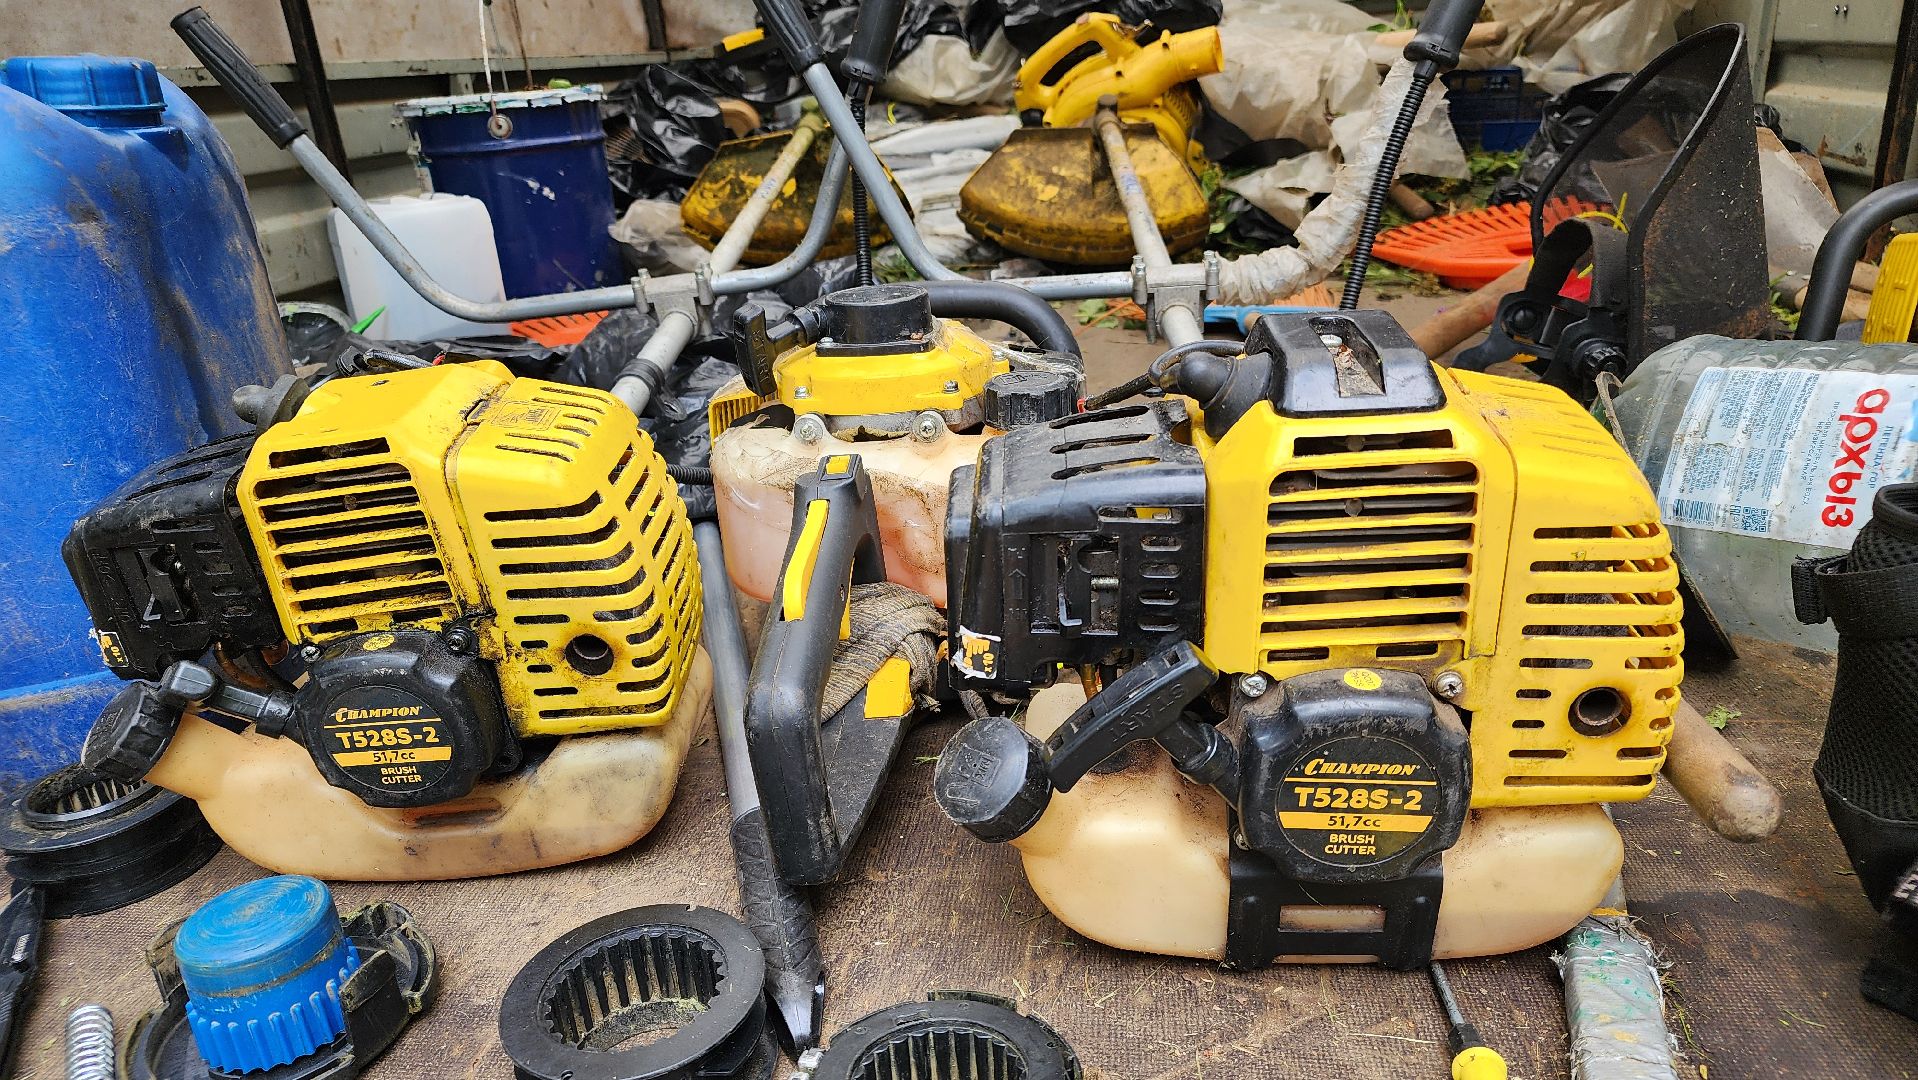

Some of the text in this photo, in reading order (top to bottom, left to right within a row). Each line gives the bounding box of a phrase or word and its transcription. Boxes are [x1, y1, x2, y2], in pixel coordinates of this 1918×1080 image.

[1821, 388, 1891, 529] архыз
[332, 706, 421, 723] CHAMPION
[1111, 682, 1190, 744] START
[335, 726, 440, 750] T528S-2
[380, 766, 417, 775] BRUSH
[1303, 758, 1418, 776] CHAMPION
[381, 774, 422, 785] CUTTER
[1294, 786, 1424, 811] T528S-2
[1329, 833, 1375, 845] BRUSH
[1324, 844, 1376, 856] CUTTER
